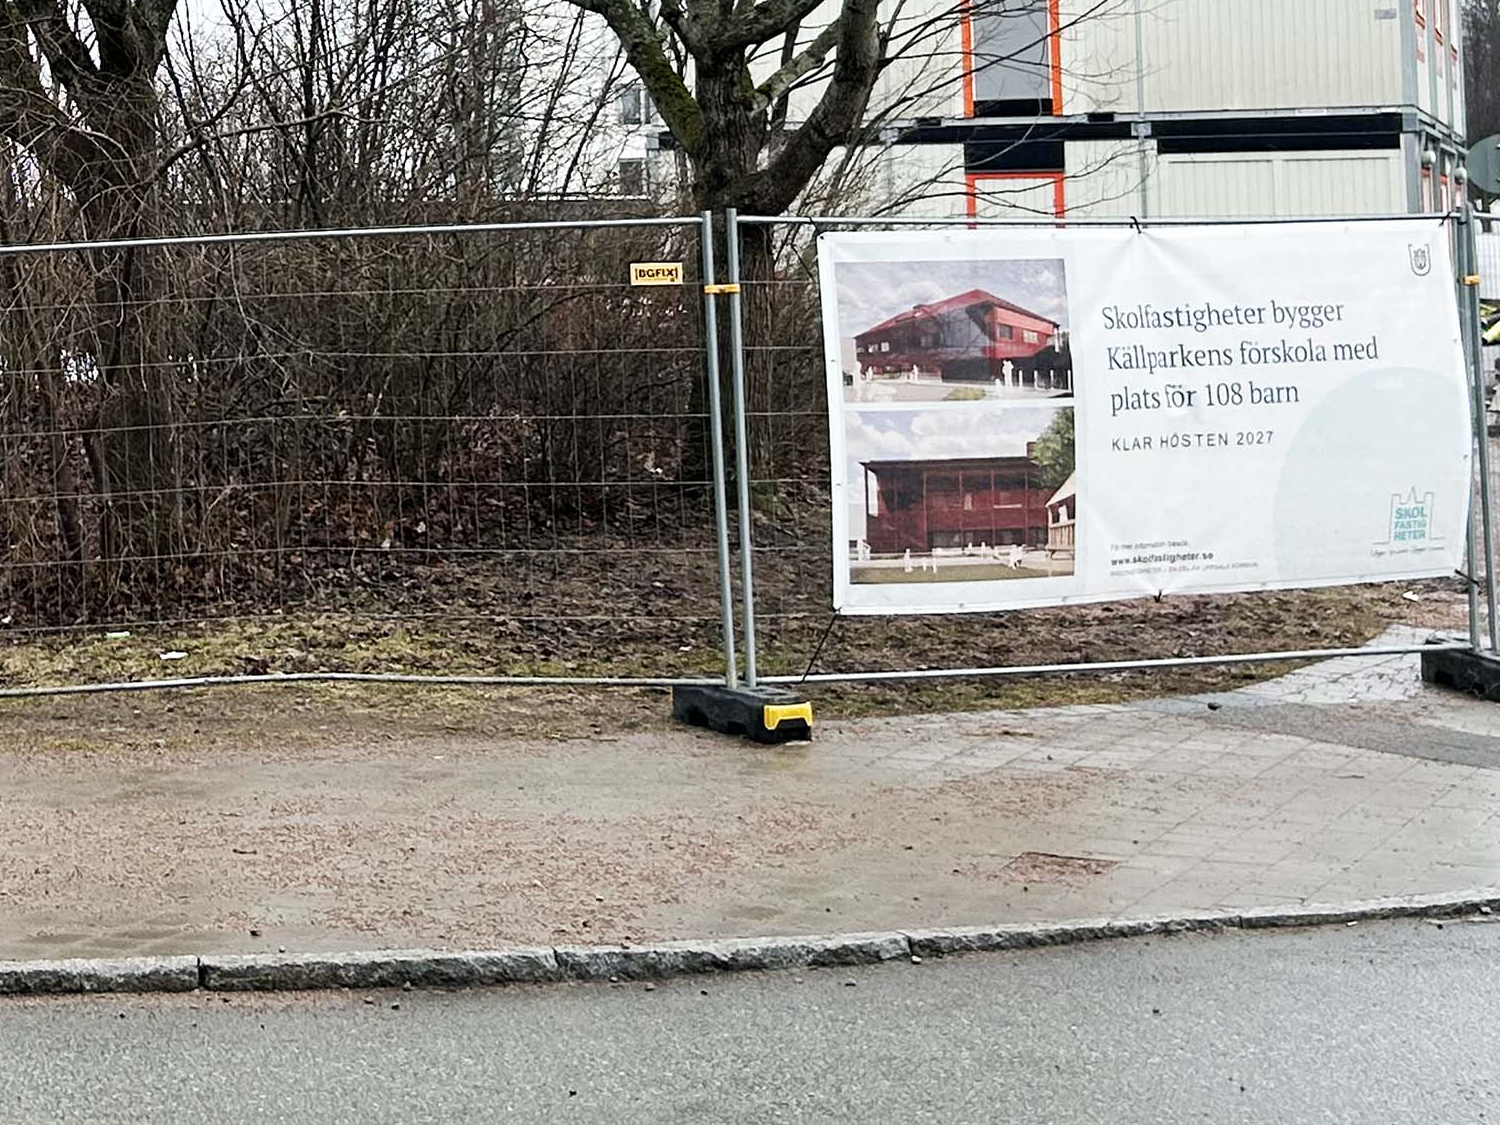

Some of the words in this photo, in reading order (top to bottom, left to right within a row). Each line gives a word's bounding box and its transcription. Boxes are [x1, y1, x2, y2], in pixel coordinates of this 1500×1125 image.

[1101, 301, 1266, 333] Skolfastigheter
[1270, 299, 1344, 330] bygger
[1107, 343, 1234, 375] Källparkens
[1239, 337, 1327, 366] förskola
[1332, 335, 1380, 362] med
[1110, 386, 1161, 417] plats
[1164, 383, 1197, 408] för
[1205, 381, 1244, 408] 108
[1249, 381, 1301, 405] barn
[1111, 435, 1153, 452] KLAR
[1159, 431, 1229, 449] HÖSTEN
[1235, 430, 1274, 446] 2027
[1395, 506, 1428, 520] SKOL
[1393, 529, 1426, 541] HETER
[1394, 519, 1427, 530] FASTIG
